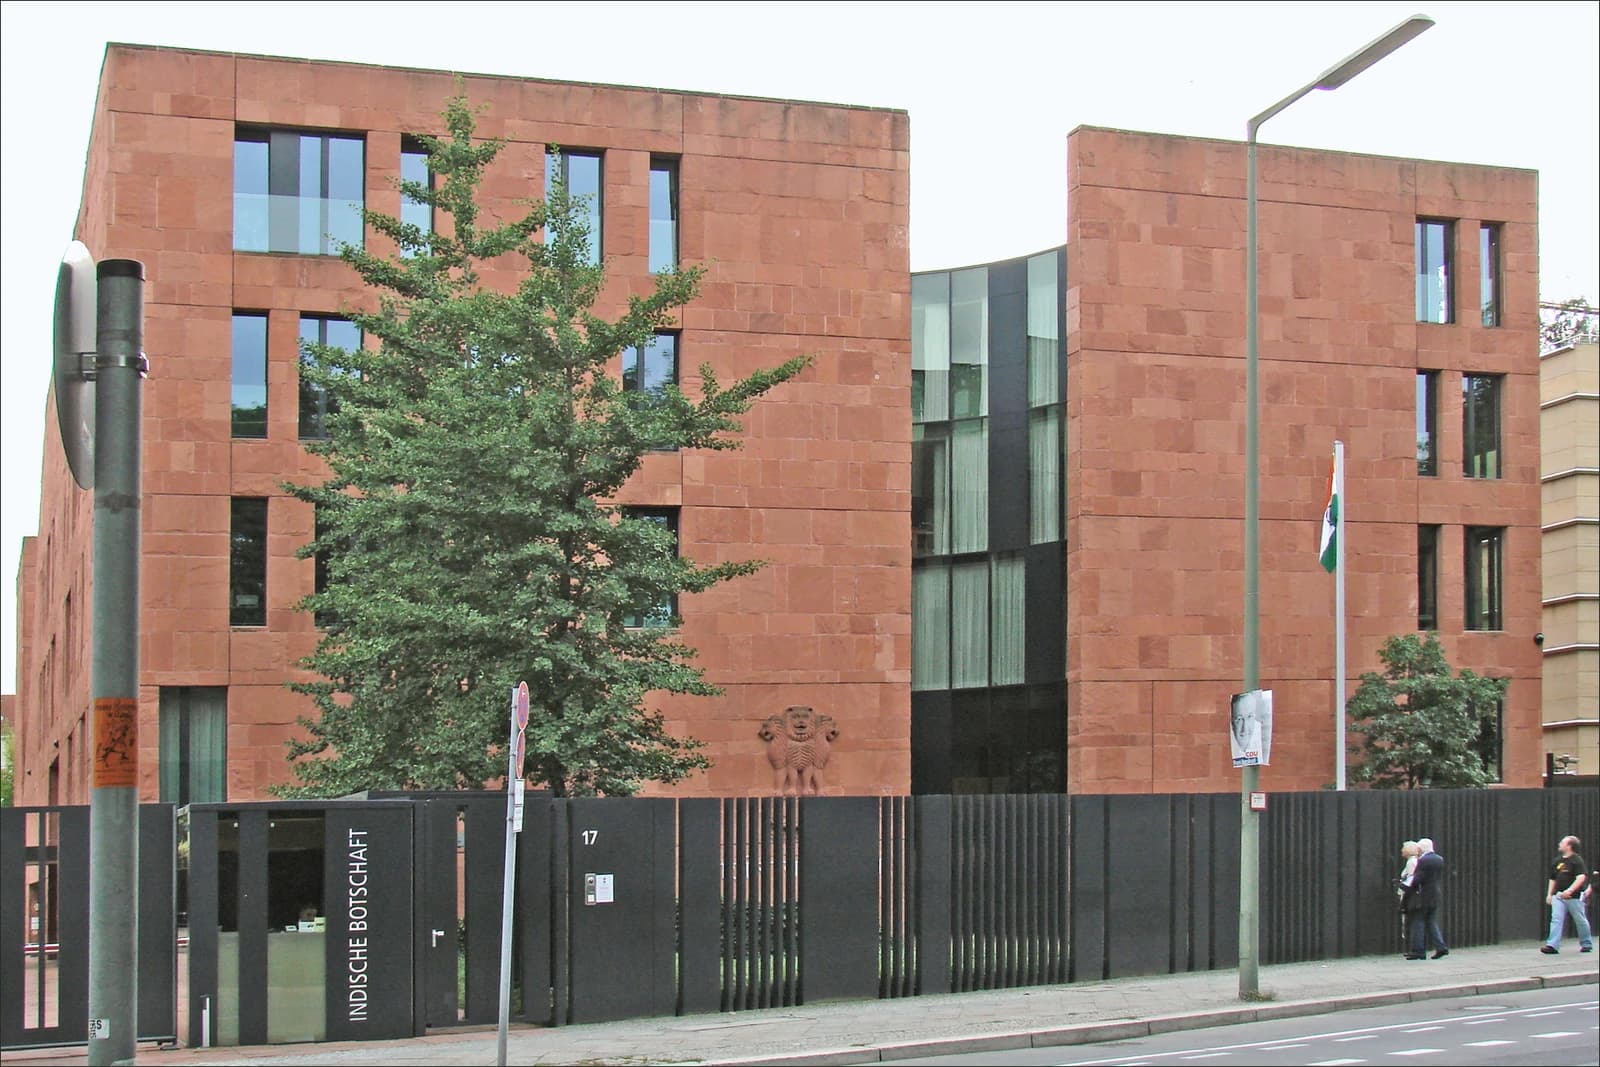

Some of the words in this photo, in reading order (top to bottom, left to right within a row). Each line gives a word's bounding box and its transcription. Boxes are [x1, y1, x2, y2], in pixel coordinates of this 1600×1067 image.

[348, 828, 368, 931] BOTSCHAFT
[581, 830, 599, 845] 17
[348, 937, 368, 1021] INDISCHE
